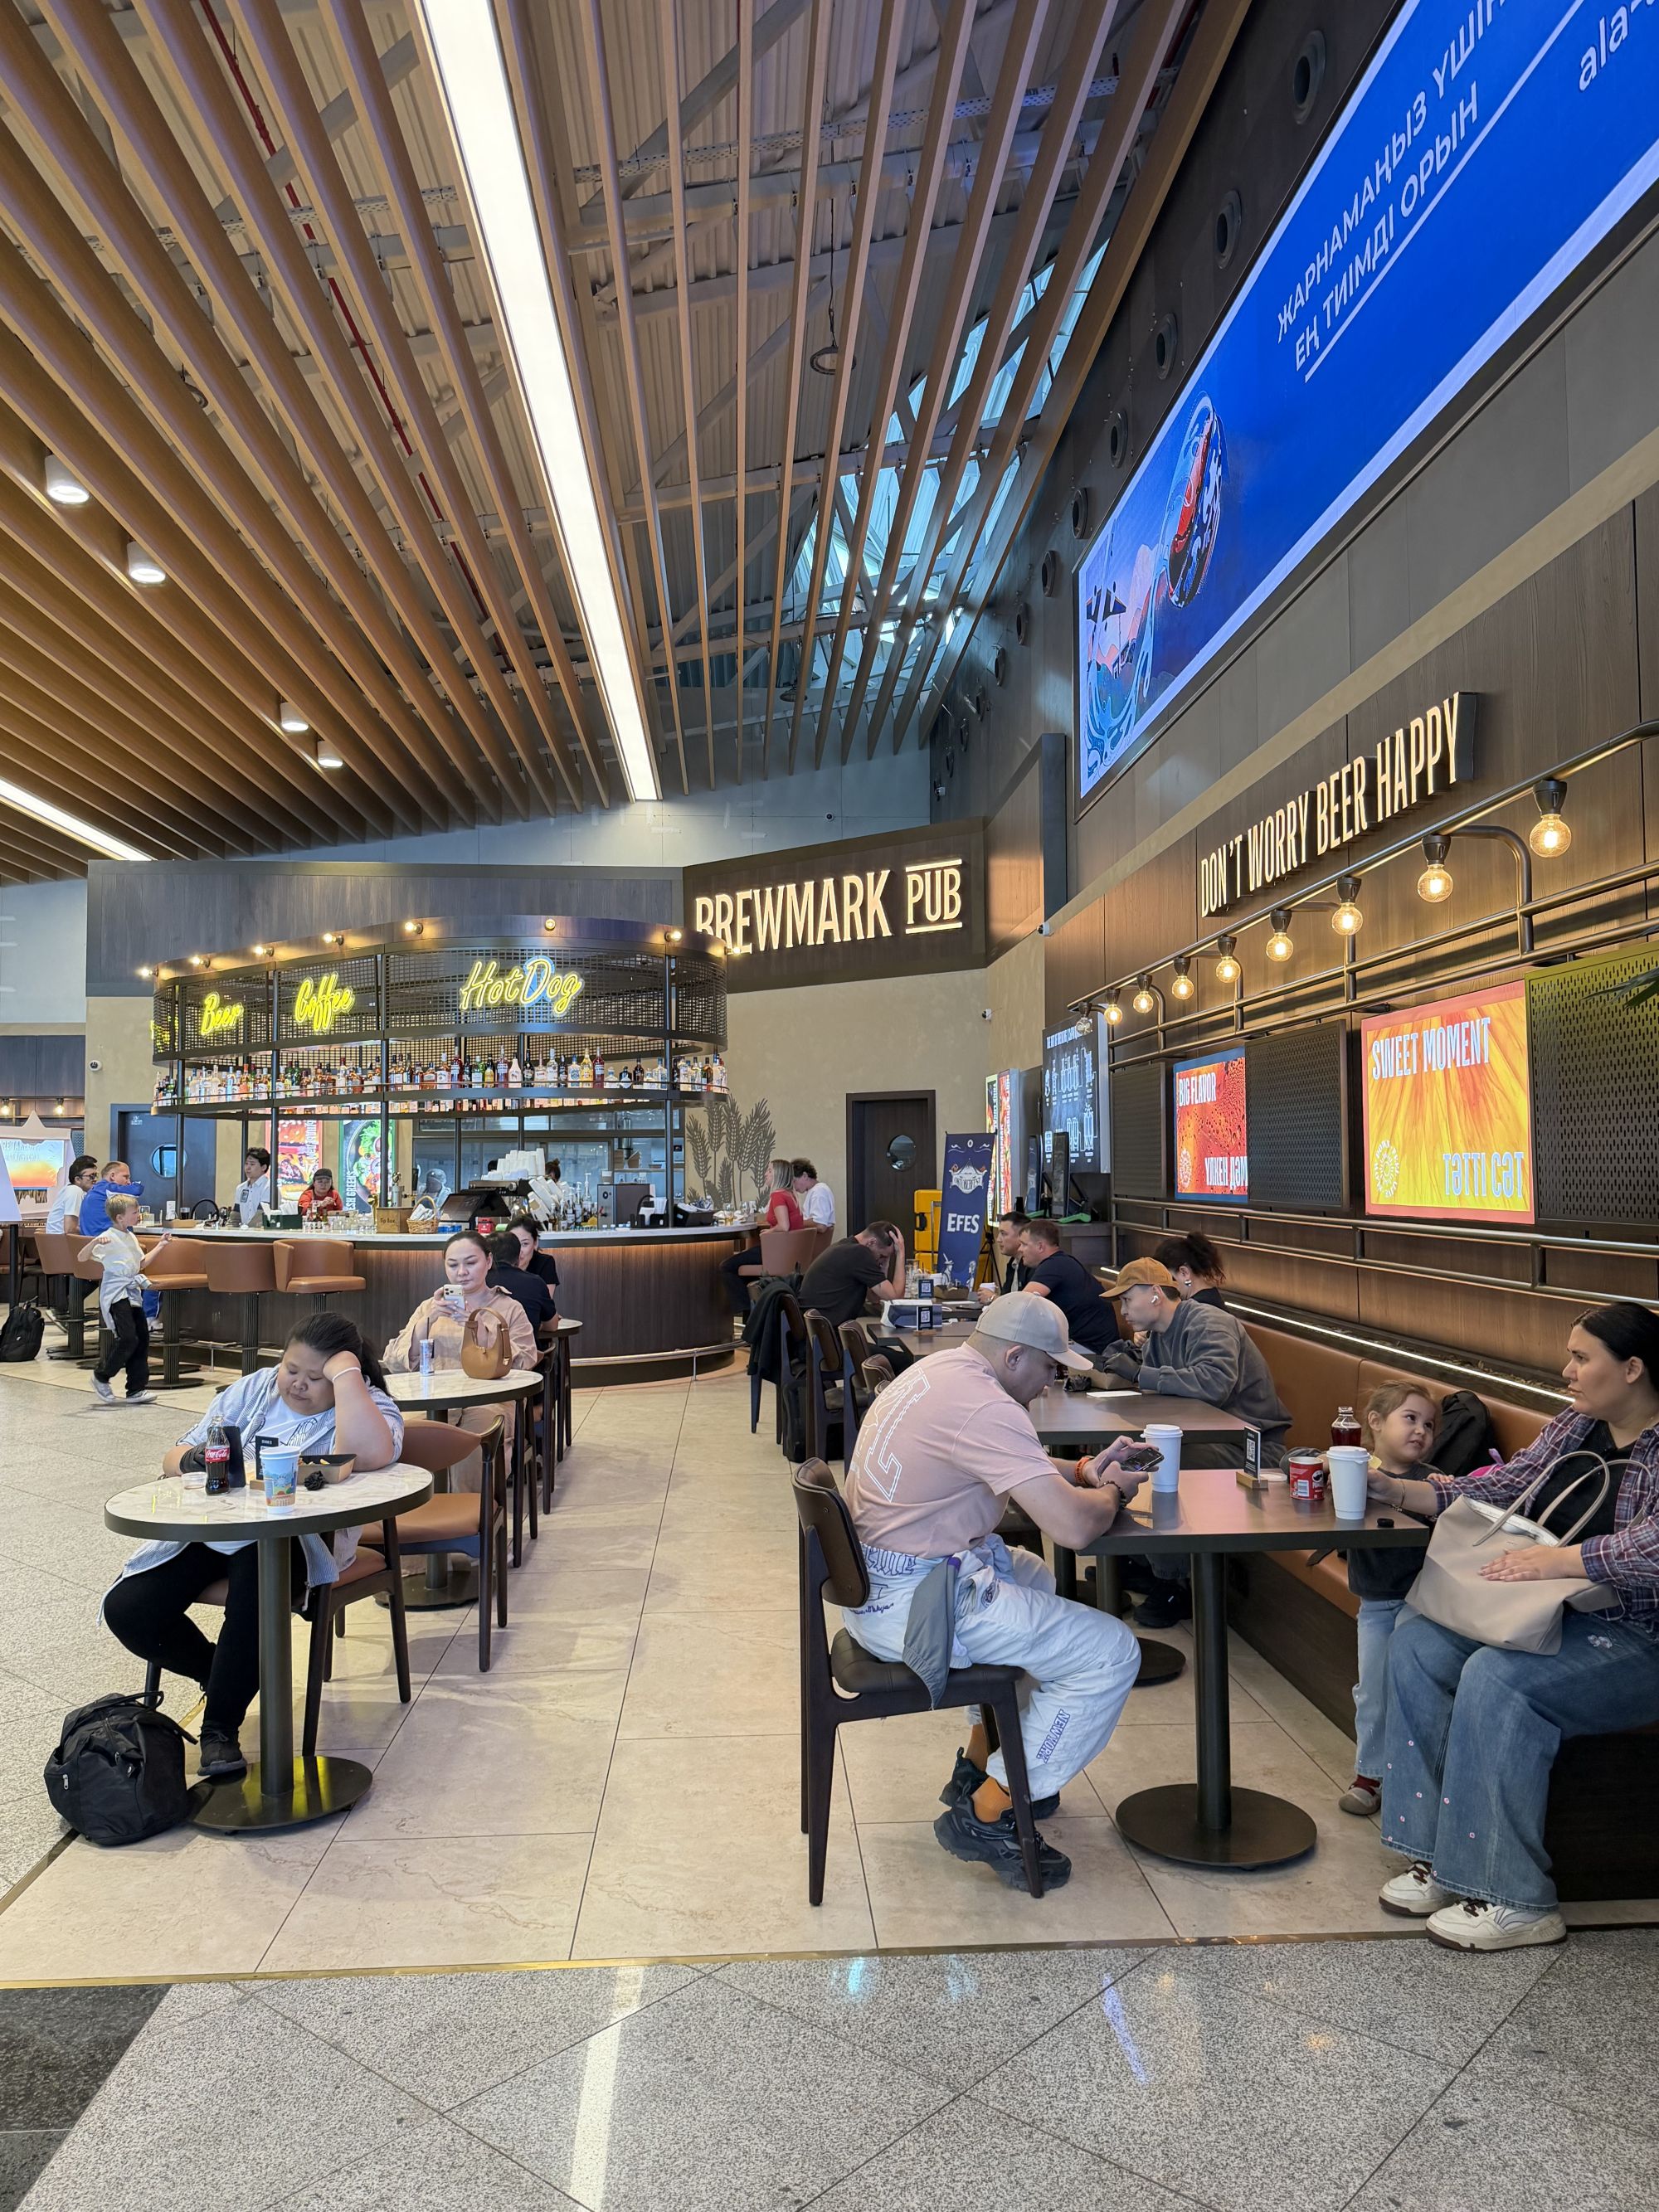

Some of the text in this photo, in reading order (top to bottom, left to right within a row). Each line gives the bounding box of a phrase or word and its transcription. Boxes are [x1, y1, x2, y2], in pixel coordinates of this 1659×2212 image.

[1579, 0, 1656, 91] ala-
[1400, 80, 1478, 218] ОРЫН
[1248, 790, 1310, 892] WORRY
[1316, 756, 1368, 856] BEER
[1376, 692, 1460, 823] HAPPY
[695, 868, 962, 955] BREWMARK PUB
[201, 991, 244, 1036] Beer
[294, 971, 355, 1033] Coffee
[1371, 1017, 1491, 1081] SWEET MOMENT
[1179, 1072, 1217, 1107] BIG FLAVOR
[946, 1213, 980, 1234] EFES
